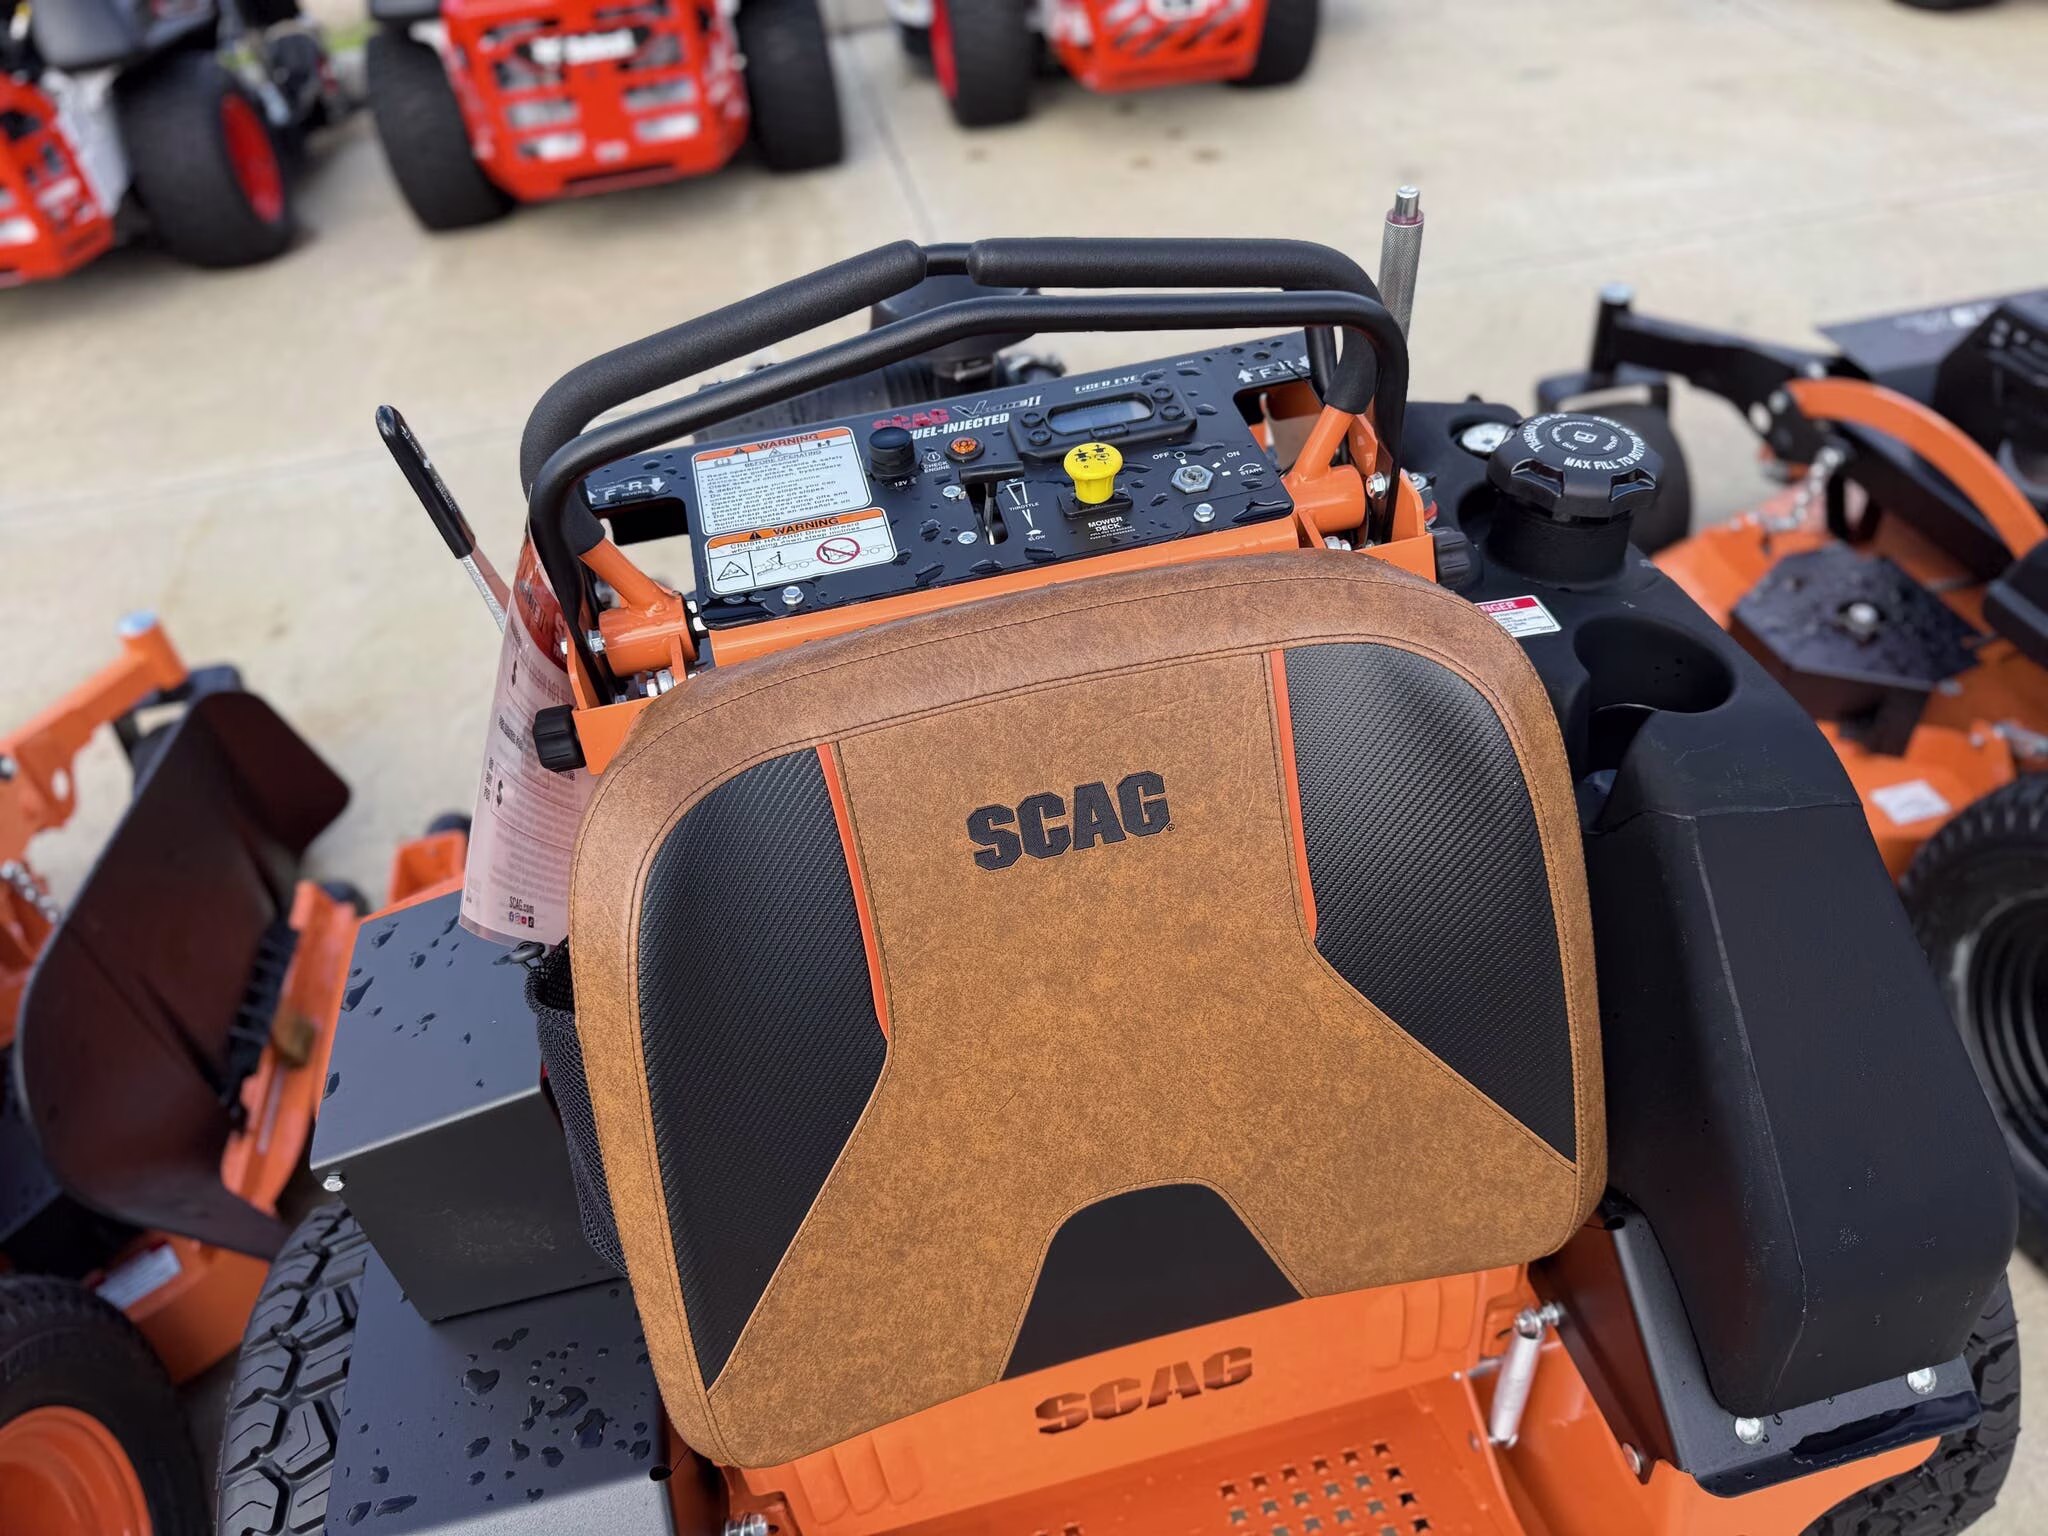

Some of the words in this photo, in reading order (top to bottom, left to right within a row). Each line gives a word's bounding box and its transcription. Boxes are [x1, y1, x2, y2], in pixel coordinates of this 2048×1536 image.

[1113, 374, 1138, 387] EYE
[909, 412, 1010, 440] UEL-INJECTED
[757, 433, 819, 450] WARNING
[744, 459, 775, 467] BEFORE
[777, 450, 821, 461] OPERATING
[1152, 452, 1169, 460] OFF
[1226, 450, 1240, 458] ON
[1564, 457, 1591, 470] MAX
[1593, 459, 1620, 470] FILL
[1618, 456, 1634, 467] TO
[1629, 435, 1647, 461] BOTTOM
[923, 461, 947, 470] CHECK
[924, 465, 950, 474] ENGINE
[1239, 467, 1262, 476] START
[604, 489, 617, 501] F
[628, 481, 642, 491] R
[621, 489, 651, 497] REVERSE
[1009, 502, 1040, 511] THROTTLE
[773, 517, 839, 535] WARNING
[1088, 516, 1123, 528] MOWER
[1095, 522, 1120, 532] DECK
[730, 538, 761, 550] CRUSH
[805, 527, 826, 535] Drive
[828, 521, 859, 530] forward
[1028, 534, 1046, 542] SLOW
[1480, 601, 1516, 612] NGER
[966, 771, 1170, 871] SCAG
[509, 896, 534, 915] SCAG.com
[1035, 1346, 1253, 1434] SCAG
